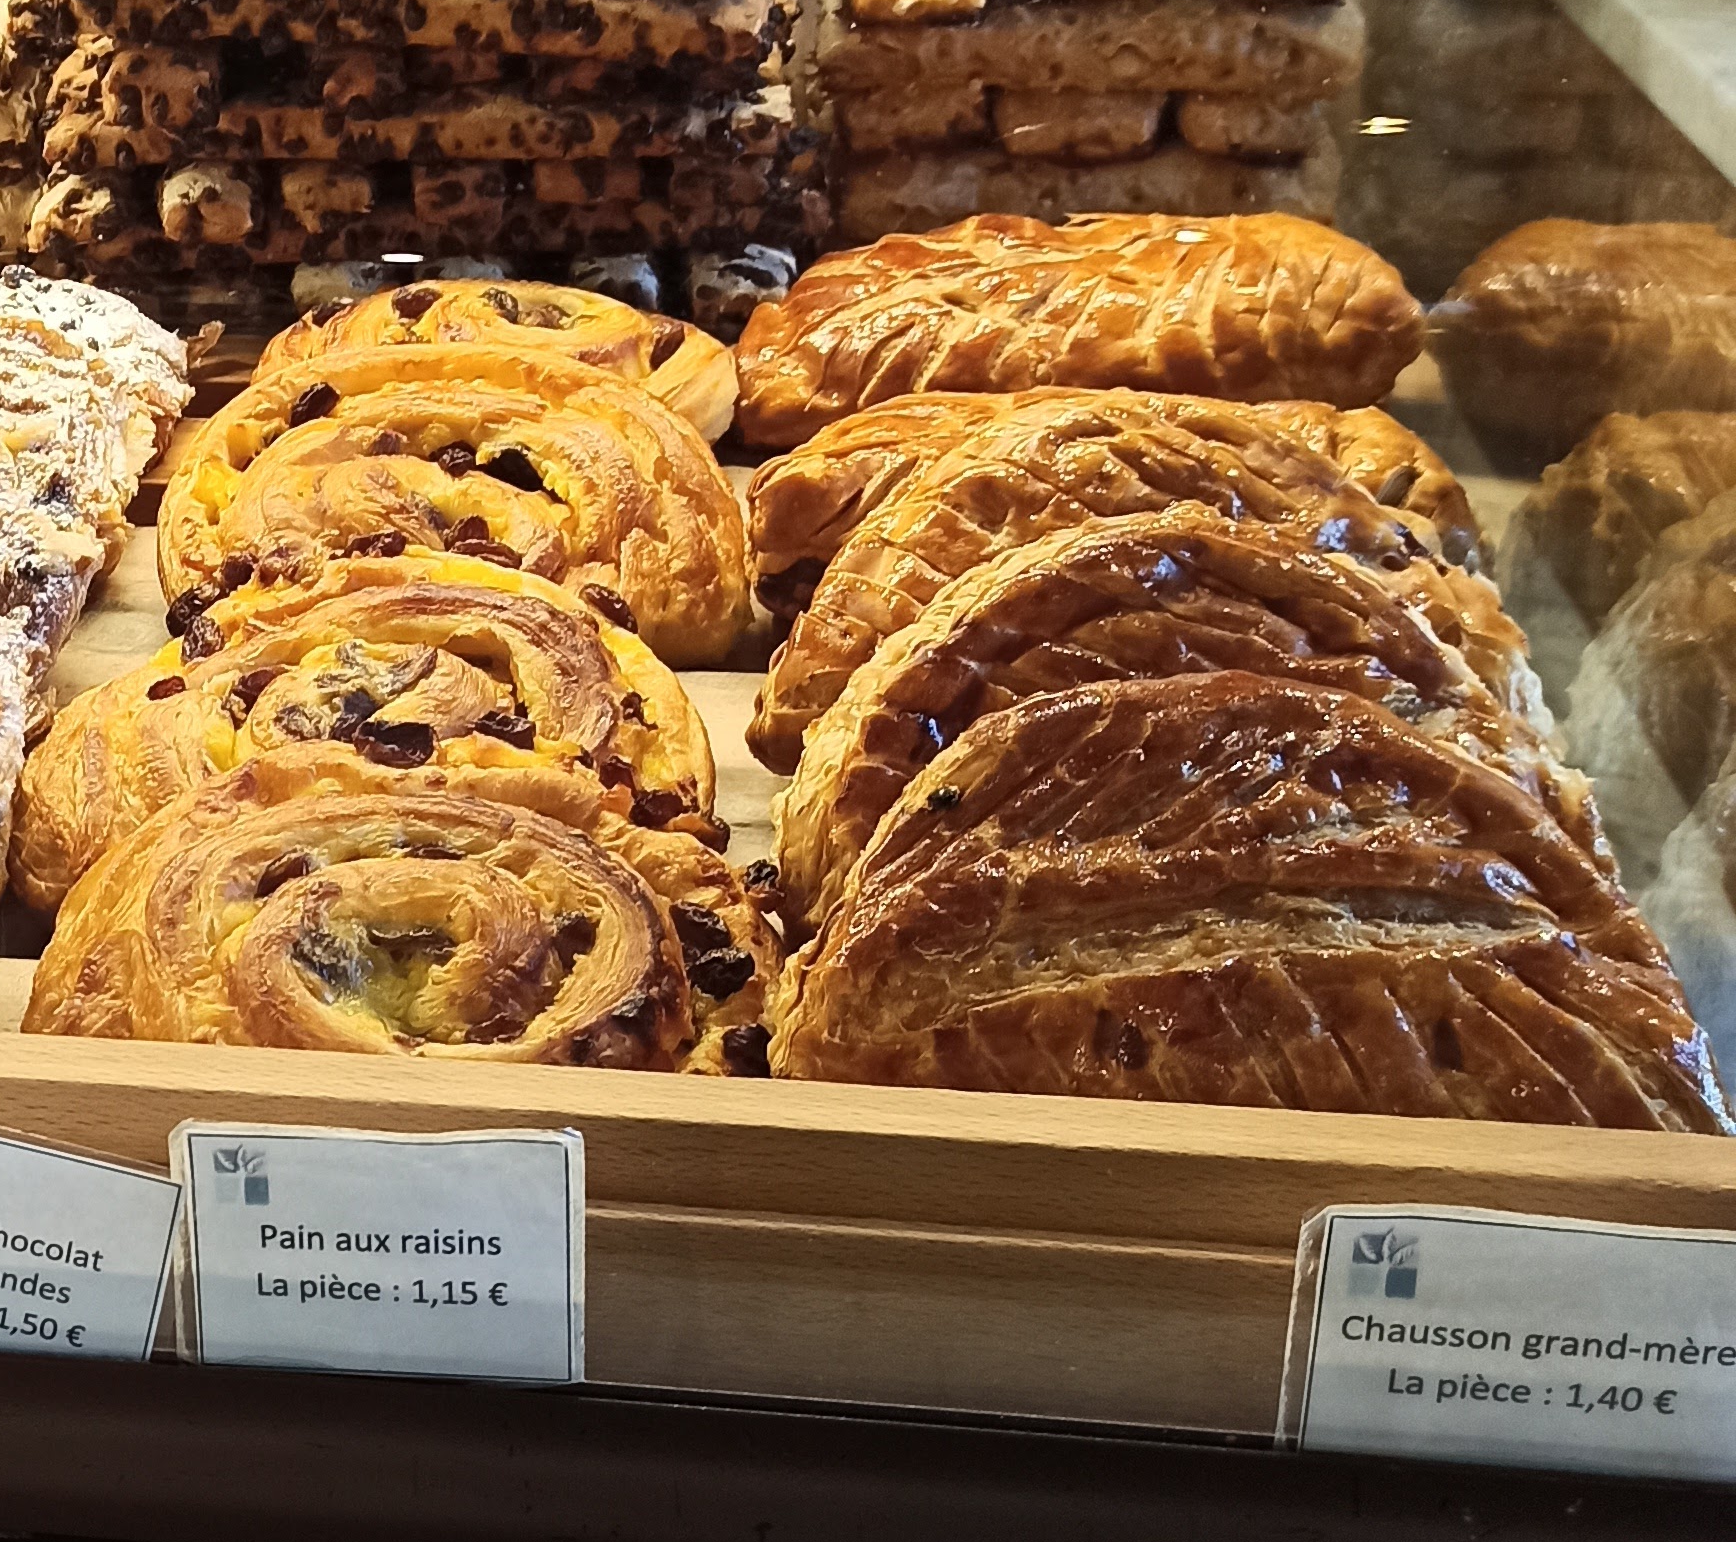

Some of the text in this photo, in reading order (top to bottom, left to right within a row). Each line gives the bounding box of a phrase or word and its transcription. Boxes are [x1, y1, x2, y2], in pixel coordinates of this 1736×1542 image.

[260, 1224, 502, 1256] Pain aux raisins
[257, 1272, 288, 1297] La
[300, 1273, 381, 1303] pièce
[412, 1279, 478, 1309] 1,15
[488, 1281, 509, 1307] €
[65, 1324, 87, 1348] €
[1341, 1314, 1736, 1367] Chausson grand-mère
[1387, 1367, 1424, 1395] La
[1436, 1373, 1531, 1404] pièce
[1566, 1382, 1644, 1414] 1,40
[1653, 1388, 1678, 1416] €
